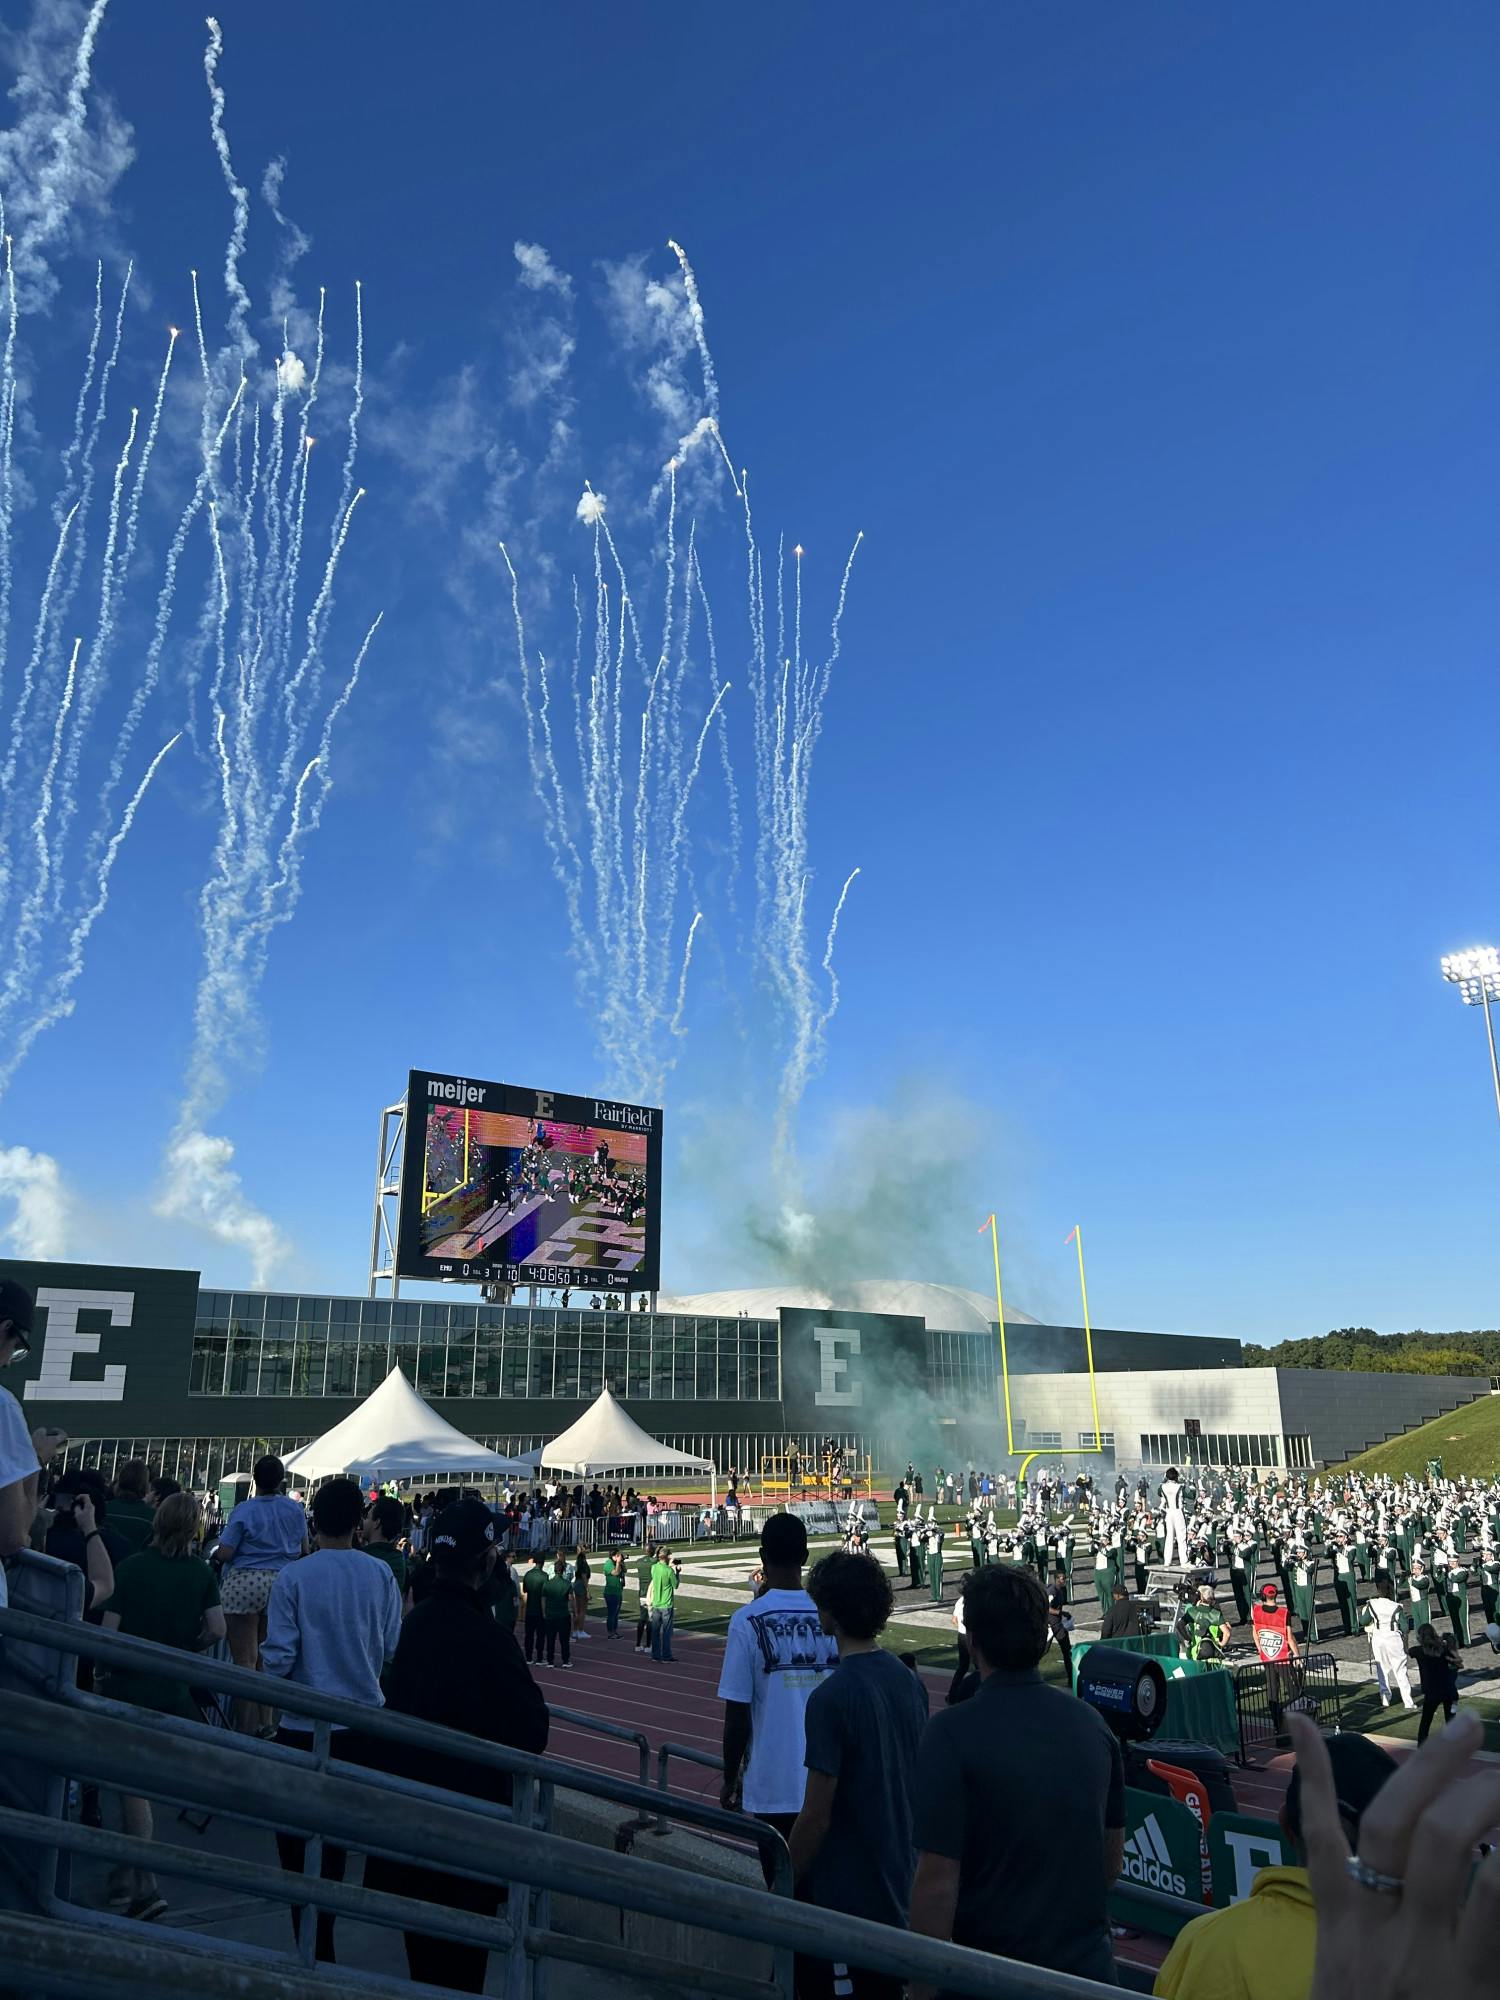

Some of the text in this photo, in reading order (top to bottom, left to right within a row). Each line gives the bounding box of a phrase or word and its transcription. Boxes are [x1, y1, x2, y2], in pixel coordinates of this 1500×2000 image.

[427, 1079, 487, 1105] meijer
[534, 1091, 555, 1118] E
[594, 1101, 653, 1127] Fairfield
[439, 1264, 453, 1272] EMU
[485, 1268, 490, 1278] 3
[507, 1269, 518, 1281] 10
[529, 1267, 555, 1282] 4:06
[557, 1273, 570, 1284] 50
[584, 1275, 589, 1284] 3
[23, 1287, 135, 1401] E
[813, 1327, 863, 1407] E
[1095, 1685, 1125, 1696] POWER
